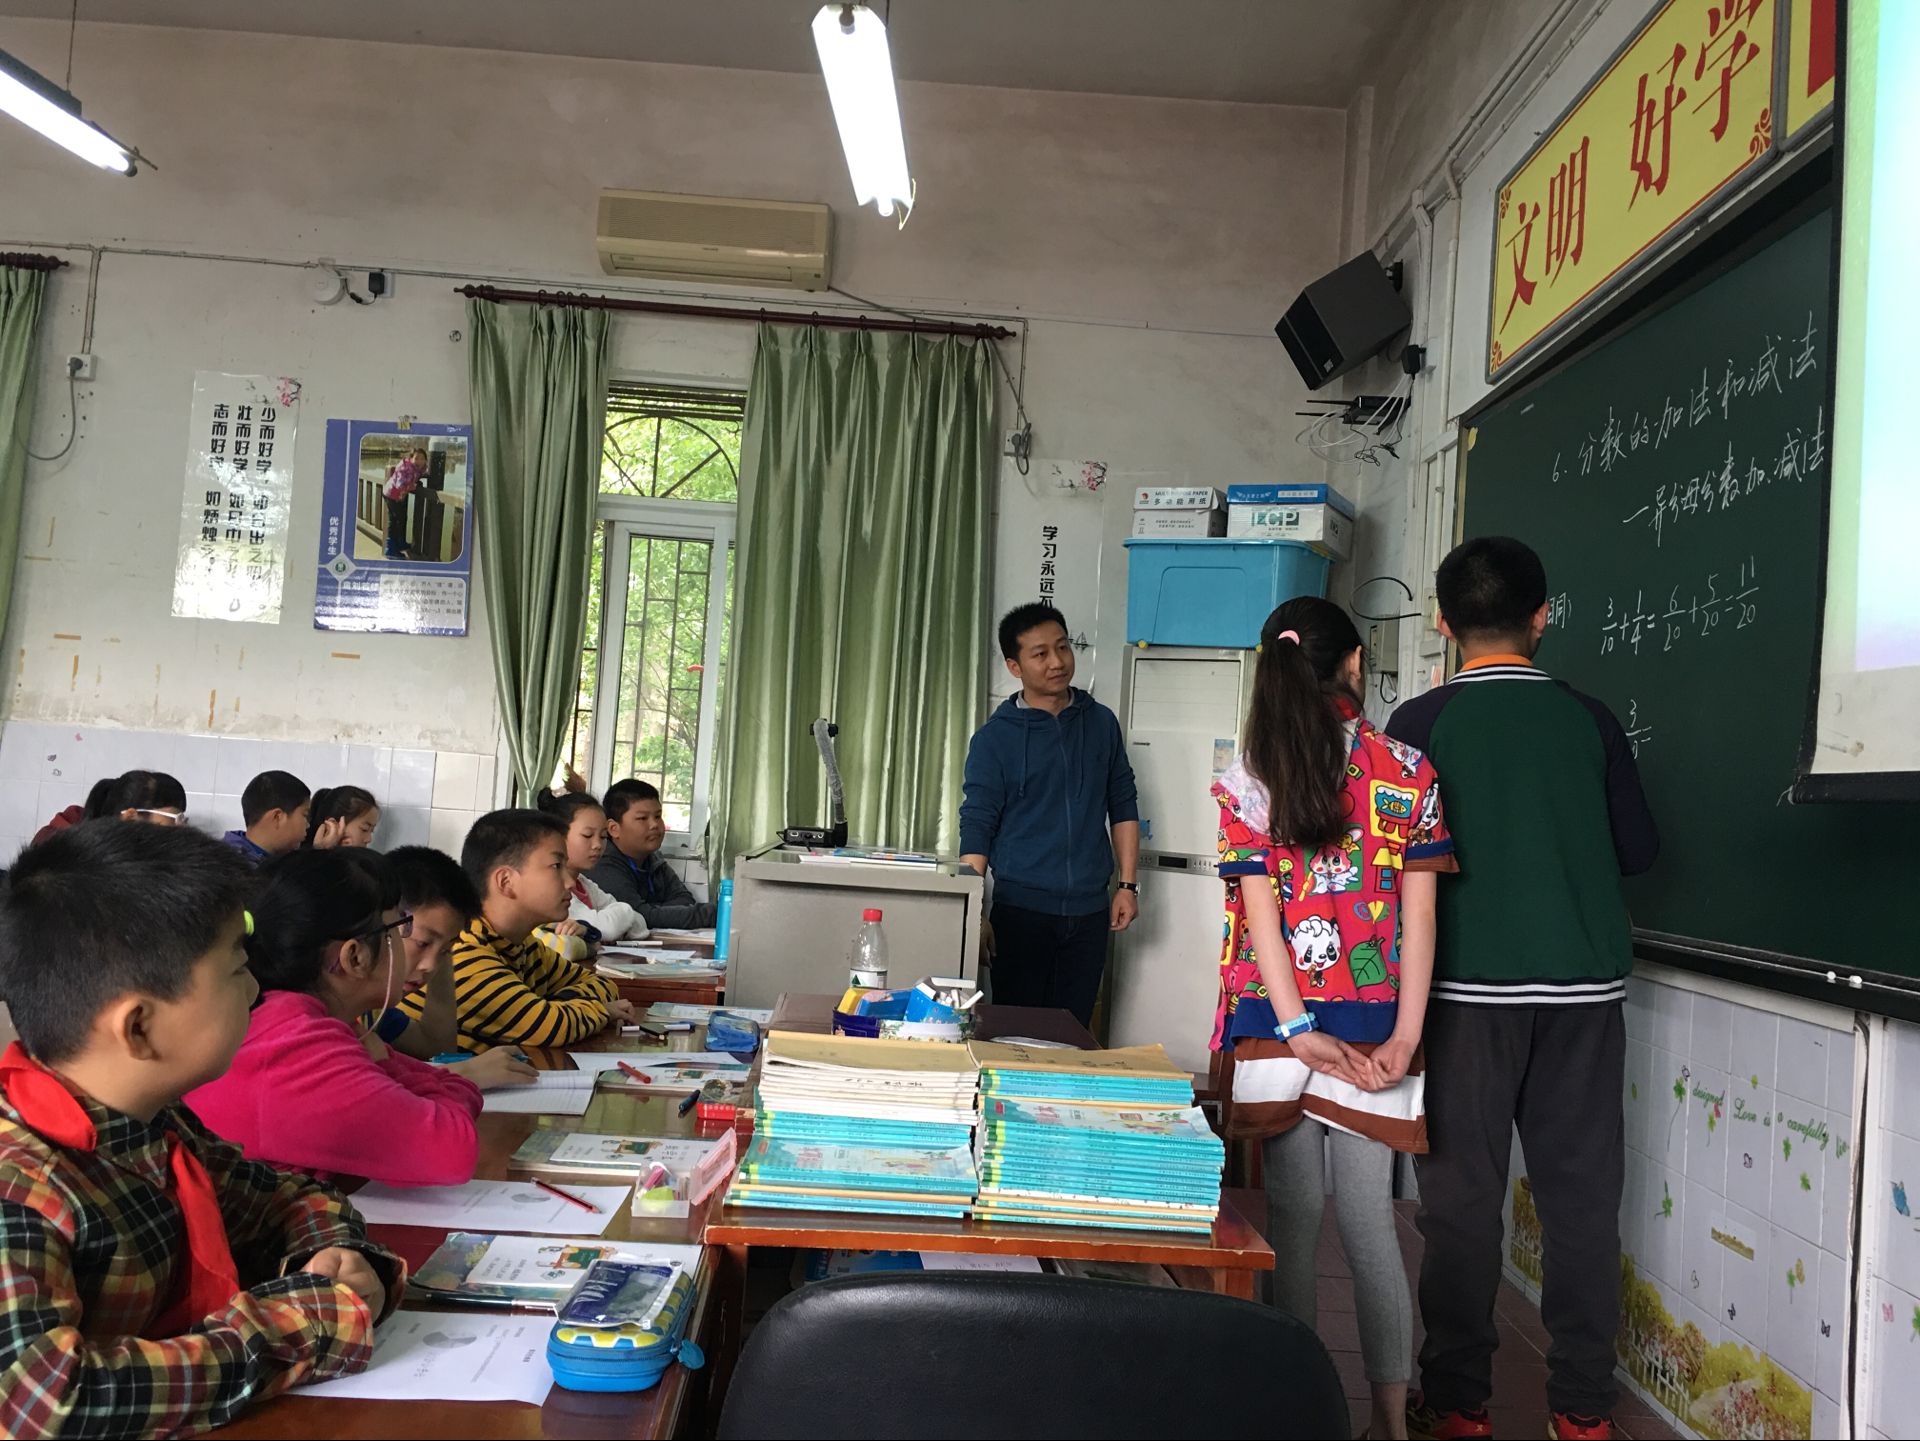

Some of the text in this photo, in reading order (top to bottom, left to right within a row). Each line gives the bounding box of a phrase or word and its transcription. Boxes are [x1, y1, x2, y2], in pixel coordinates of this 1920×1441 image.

[1500, 0, 1762, 335] 文明 好学
[327, 516, 340, 556] 优秀学生
[1733, 1097, 1757, 1122] Love
[1763, 1111, 1771, 1127] is
[1787, 1118, 1829, 1151] carefully
